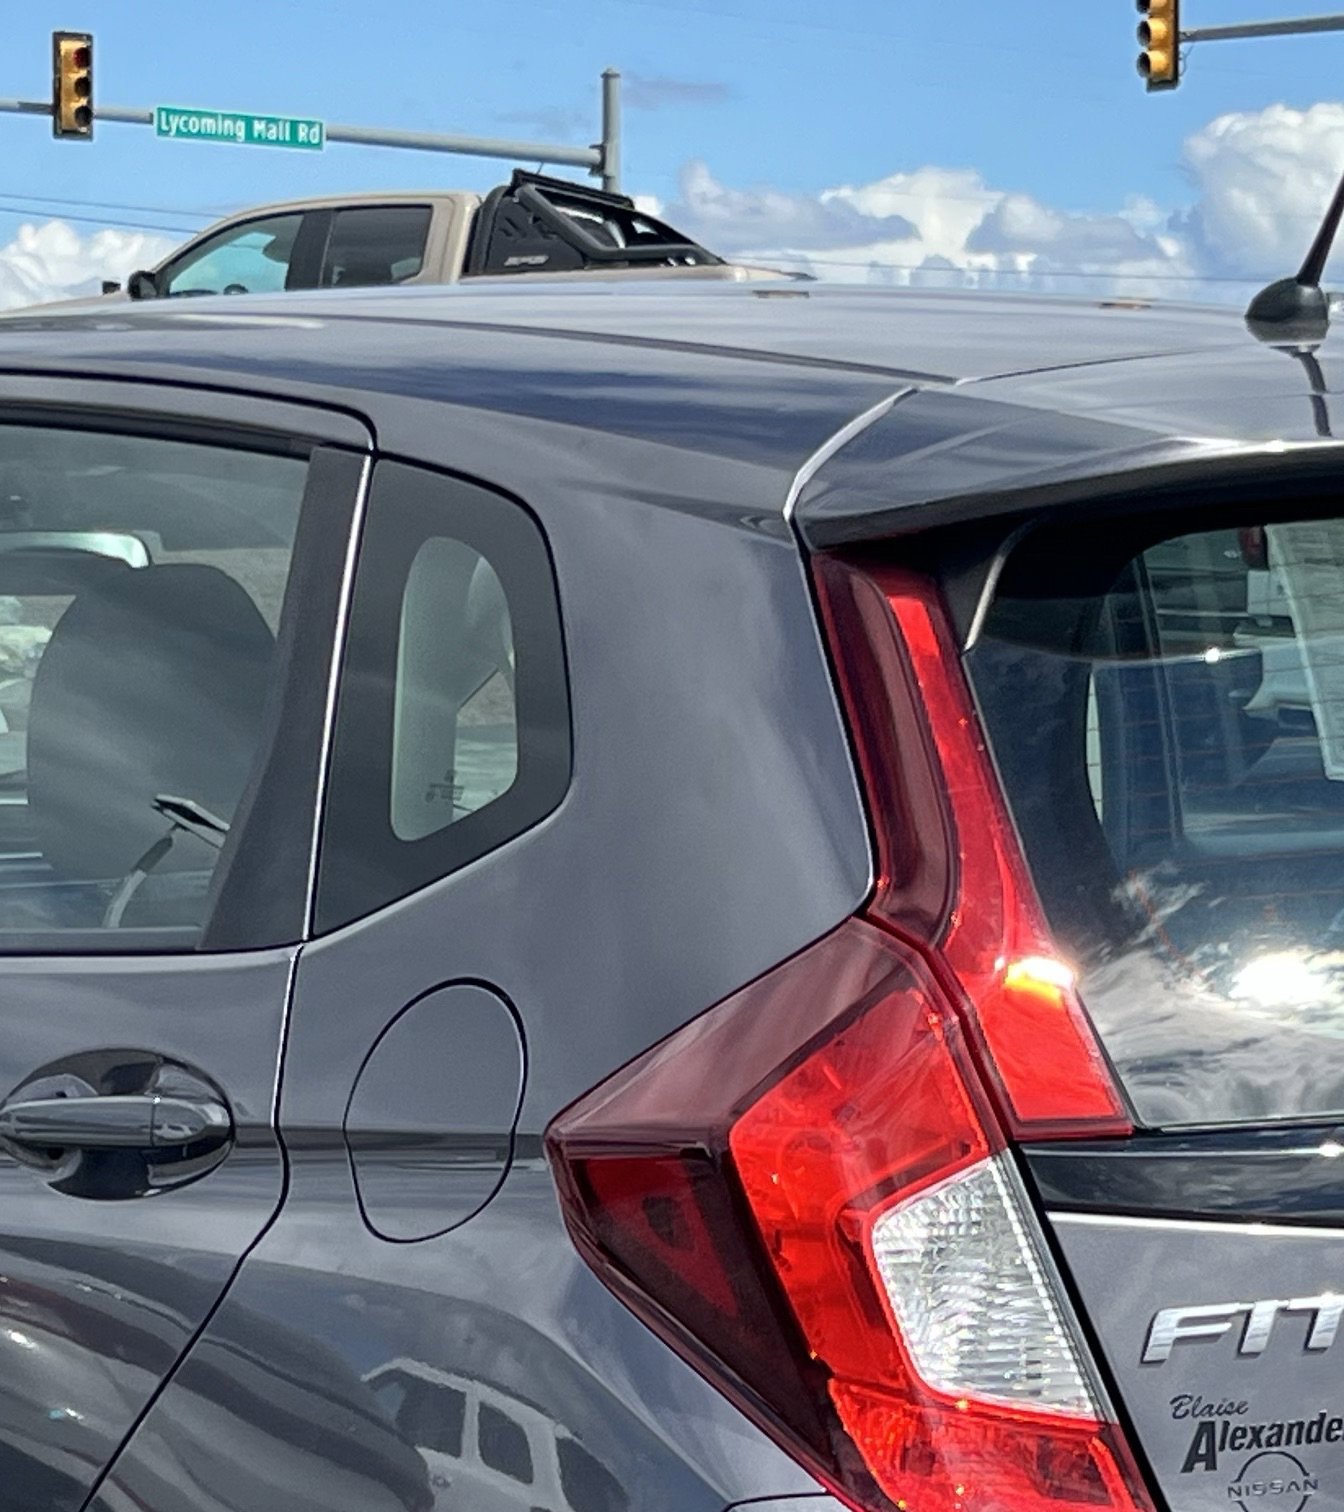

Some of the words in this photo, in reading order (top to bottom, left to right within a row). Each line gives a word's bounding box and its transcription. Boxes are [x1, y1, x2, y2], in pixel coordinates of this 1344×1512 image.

[161, 111, 245, 142] Lycoming
[253, 119, 290, 141] Mall
[298, 123, 320, 144] Rd
[1169, 1393, 1249, 1420] Blaise
[1228, 1478, 1319, 1498] NISSAN
